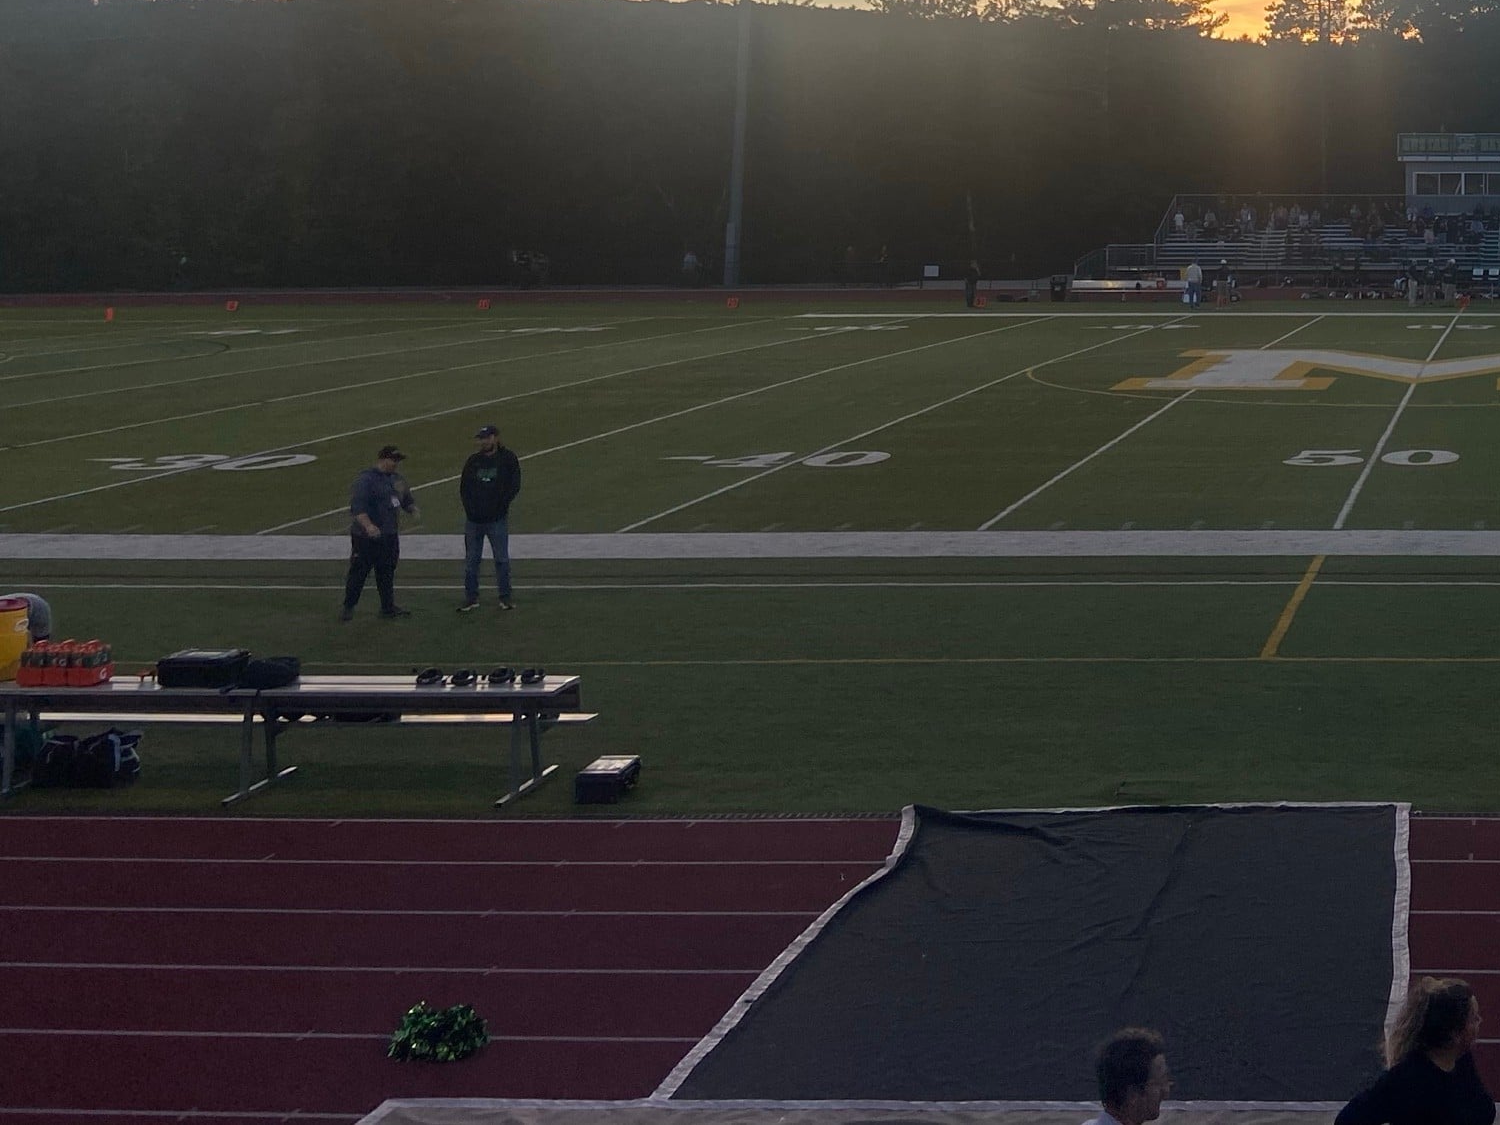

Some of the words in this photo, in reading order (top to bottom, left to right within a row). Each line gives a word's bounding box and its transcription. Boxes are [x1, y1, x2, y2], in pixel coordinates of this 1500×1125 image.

[109, 454, 318, 471] 30
[702, 451, 892, 467] 40
[1282, 449, 1460, 466] 50
